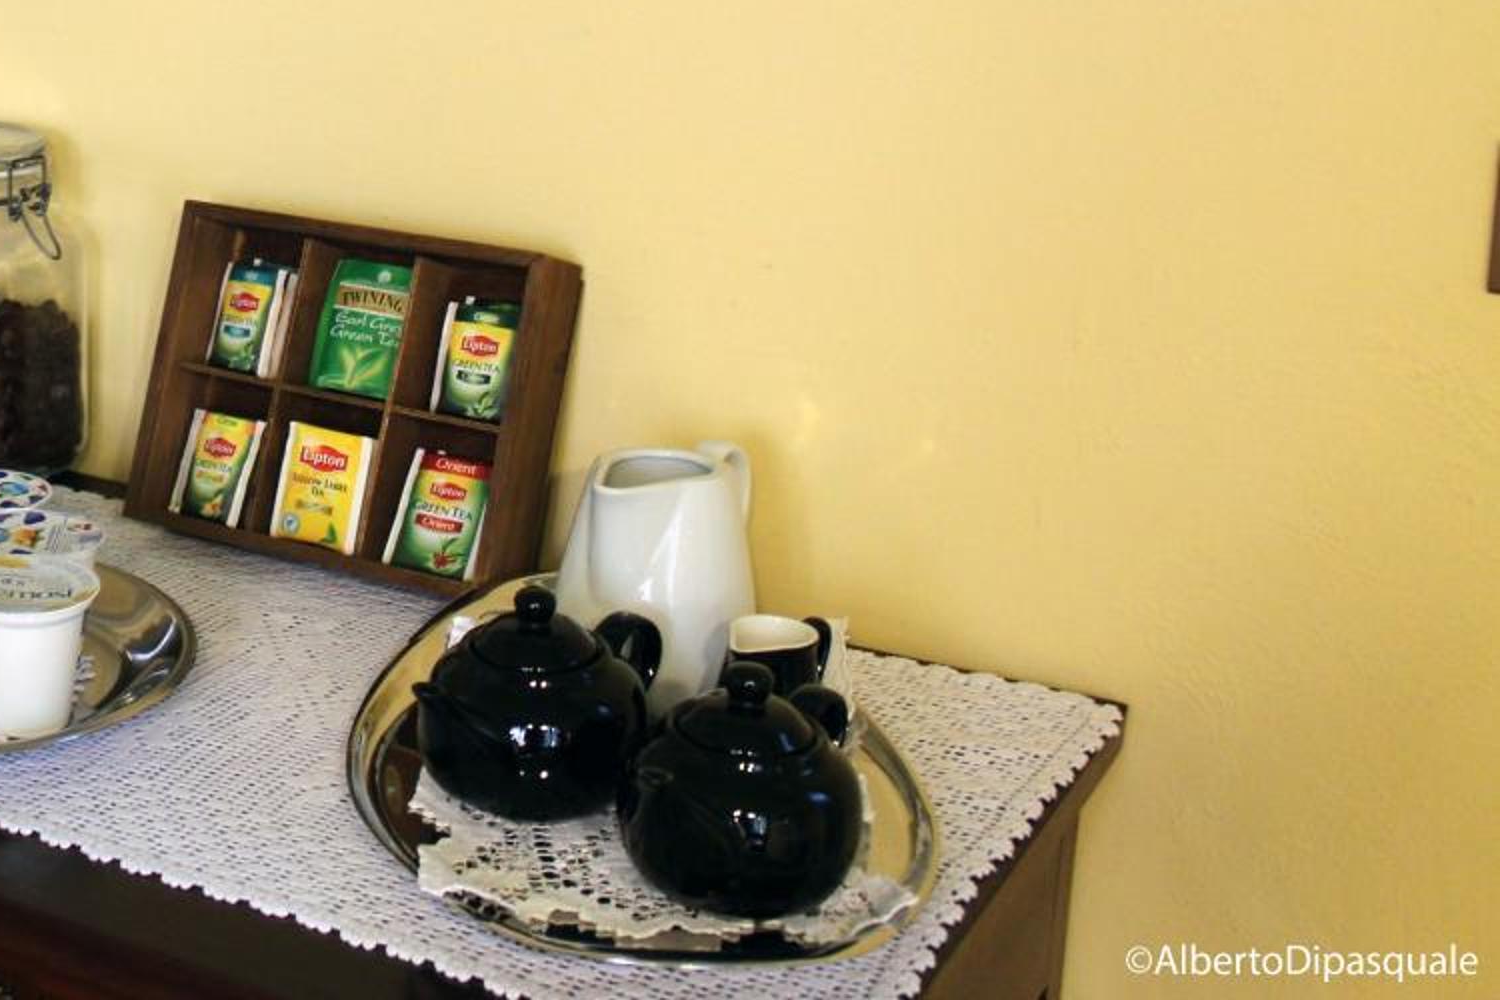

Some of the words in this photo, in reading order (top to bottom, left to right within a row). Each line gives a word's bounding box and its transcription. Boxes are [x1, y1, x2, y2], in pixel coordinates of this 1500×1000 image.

[342, 290, 404, 313] TWINING
[335, 310, 368, 327] Earl
[329, 323, 373, 343] Green
[462, 336, 498, 353] Lipton
[301, 446, 347, 469] Lipton
[435, 457, 478, 476] Orient
[430, 483, 466, 500] Lipton
[415, 500, 452, 514] GREEN
[452, 506, 473, 520] TEA
